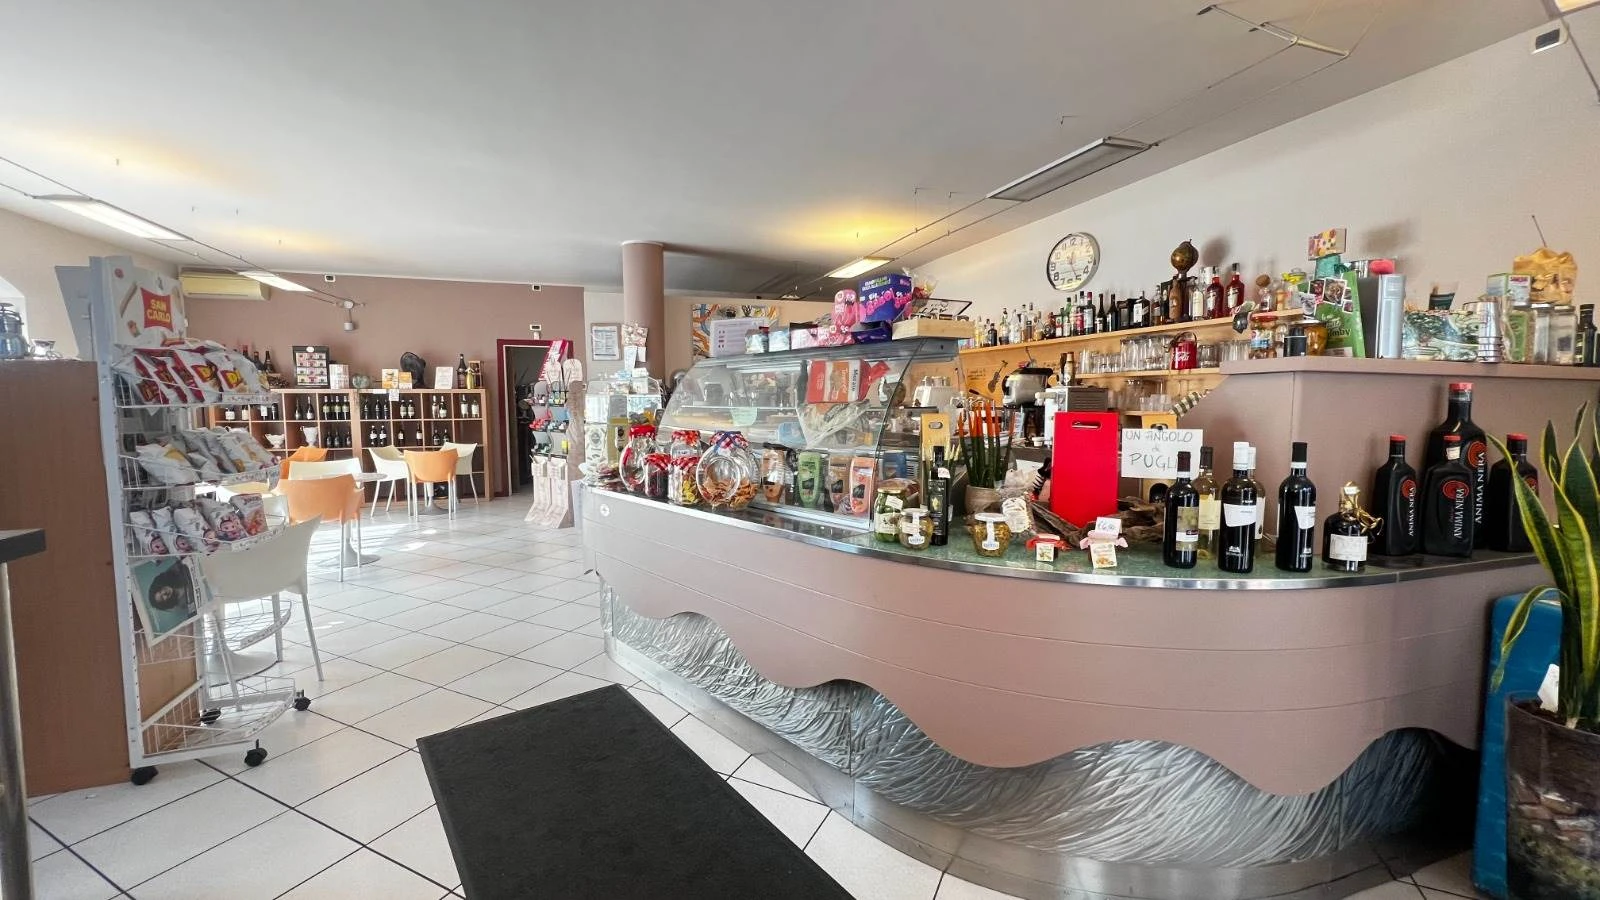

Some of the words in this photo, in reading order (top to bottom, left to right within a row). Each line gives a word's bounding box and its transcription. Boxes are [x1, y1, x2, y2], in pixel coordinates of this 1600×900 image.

[1053, 271, 1059, 281] 8
[1083, 265, 1089, 274] 4
[150, 299, 167, 311] SAN
[147, 309, 170, 322] CARLO
[1125, 430, 1141, 440] UN
[1145, 430, 1193, 443] ANGOLO
[1129, 452, 1178, 471] PUGLI
[1477, 452, 1485, 482] NERA
[1455, 488, 1465, 509] NERA
[1475, 485, 1484, 524] ANIMA
[1453, 511, 1464, 538] ANIMA
